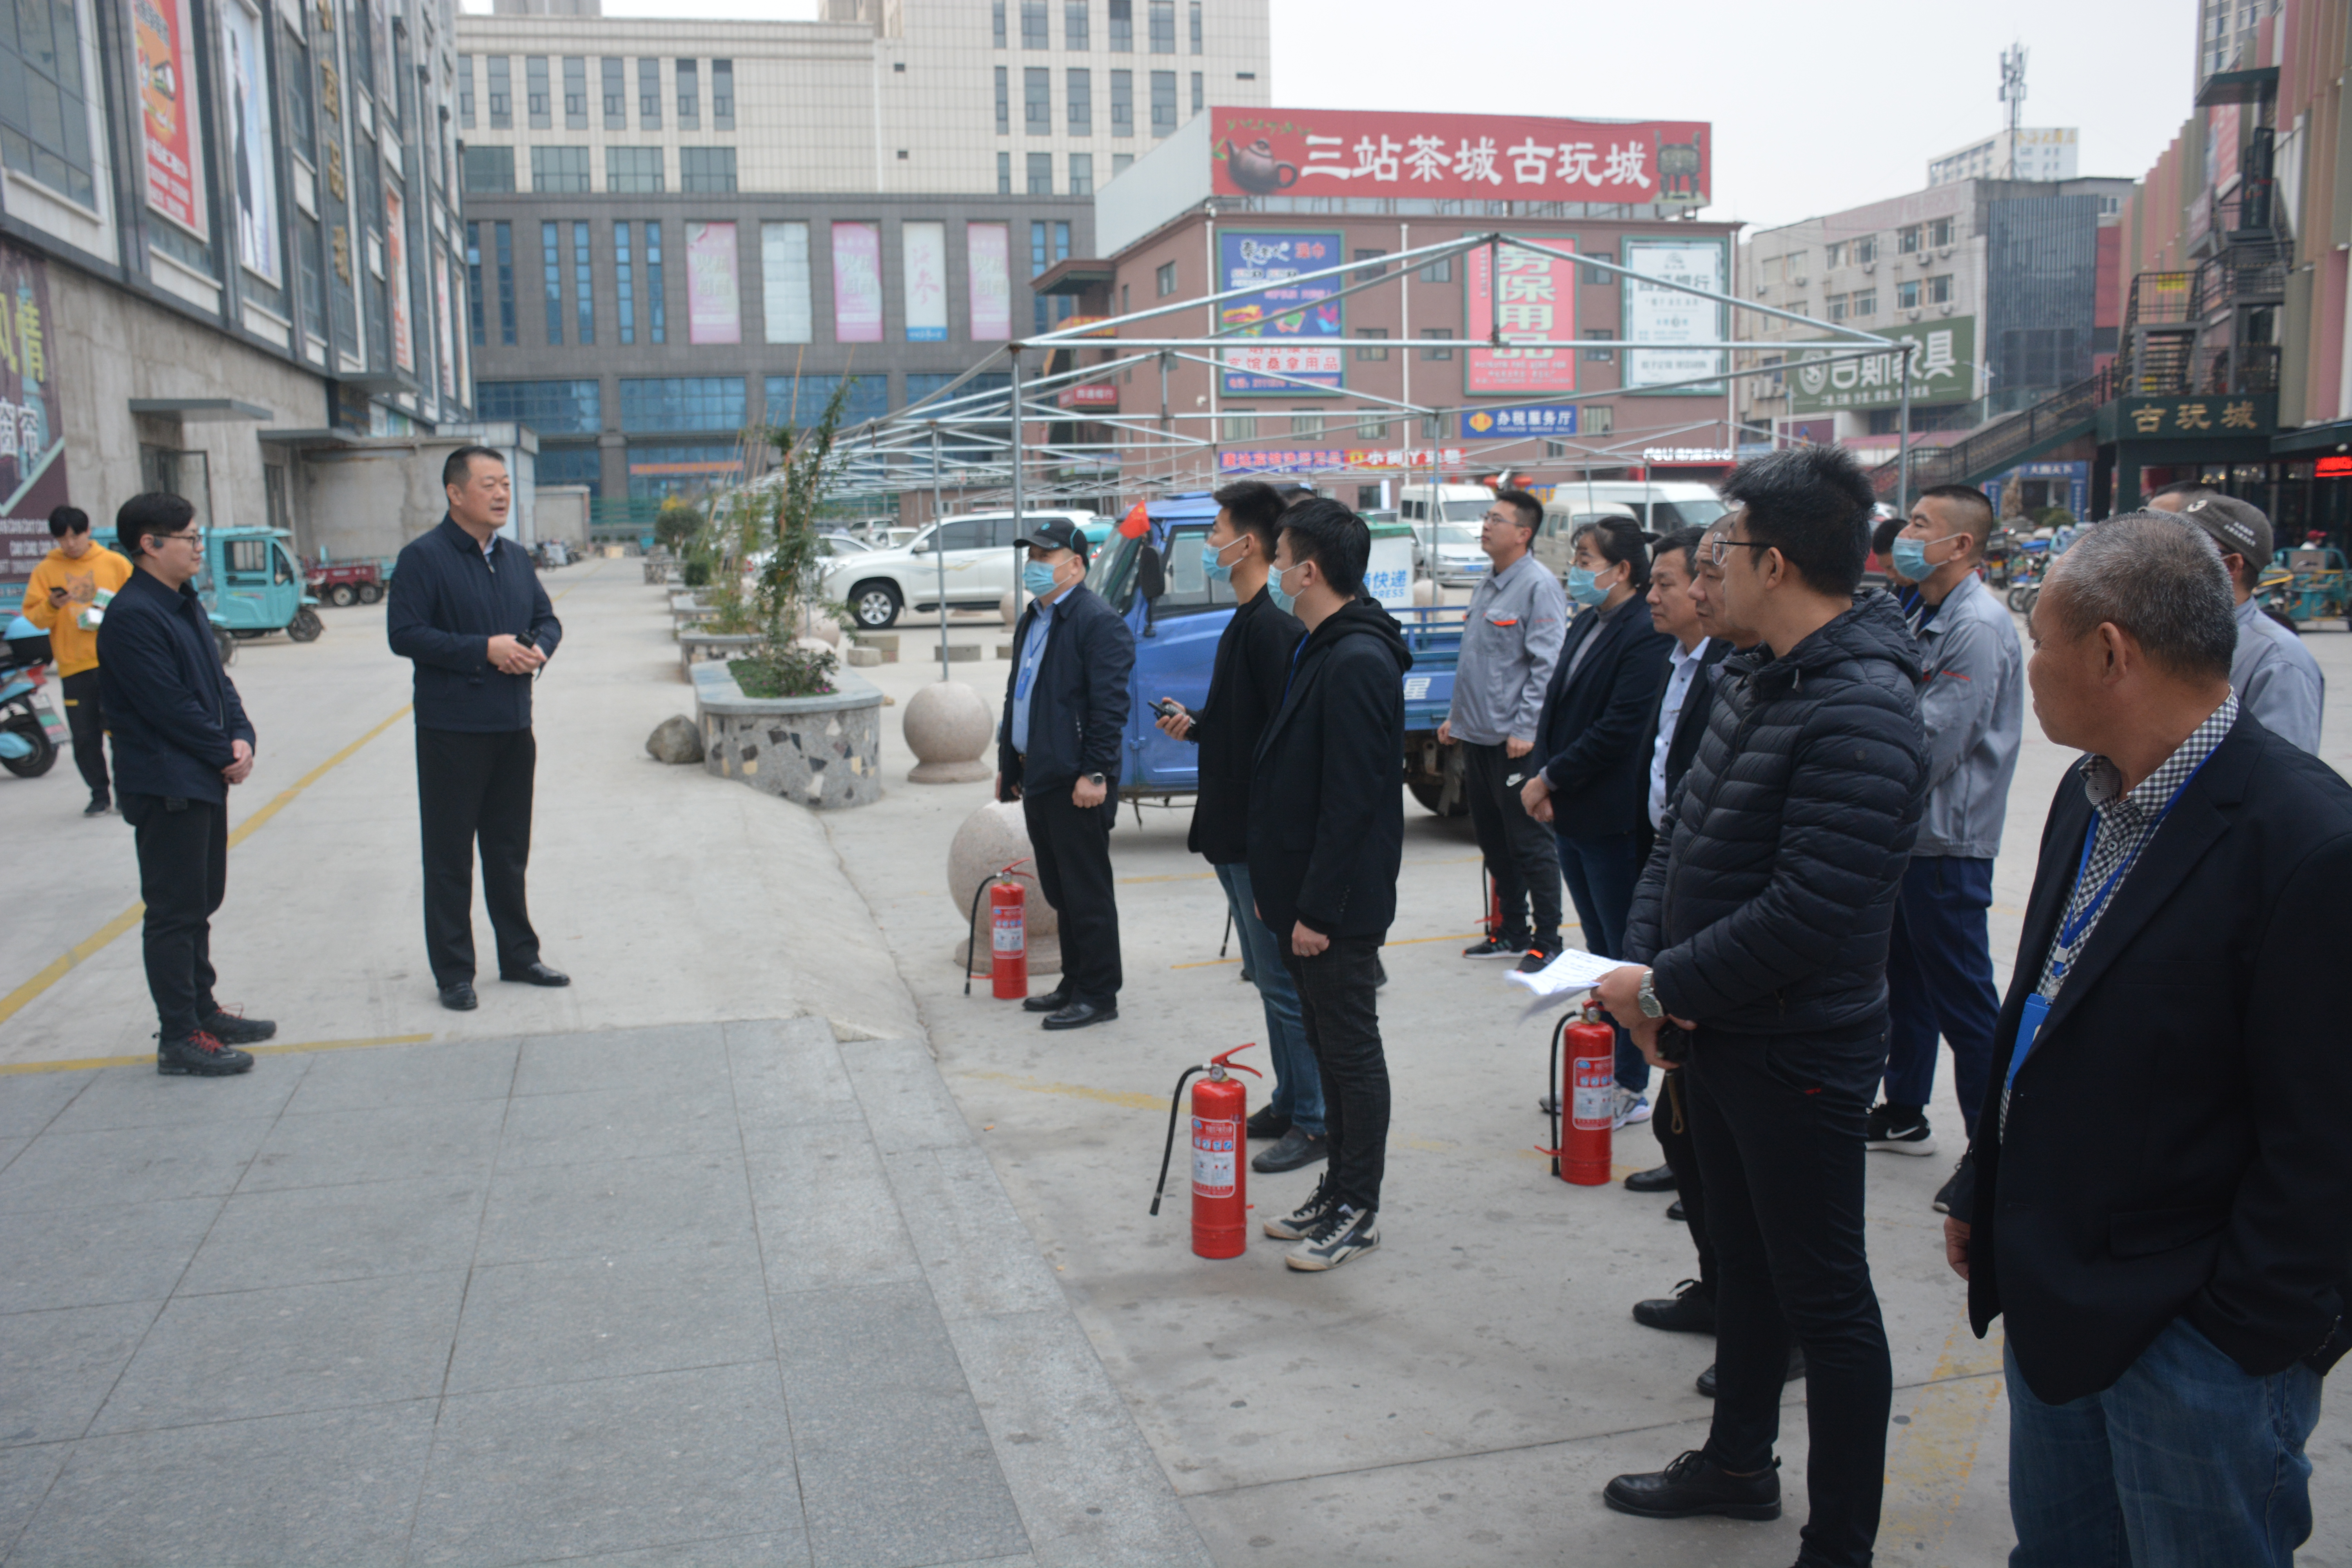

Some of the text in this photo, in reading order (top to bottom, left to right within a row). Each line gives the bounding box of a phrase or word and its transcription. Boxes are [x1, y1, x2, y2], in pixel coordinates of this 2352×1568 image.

[1301, 134, 1650, 188] 三站茶城古玩城
[1492, 245, 1555, 359] 劳保用品
[1497, 410, 1571, 426] 办税服务厅
[2130, 400, 2257, 433] 古玩城
